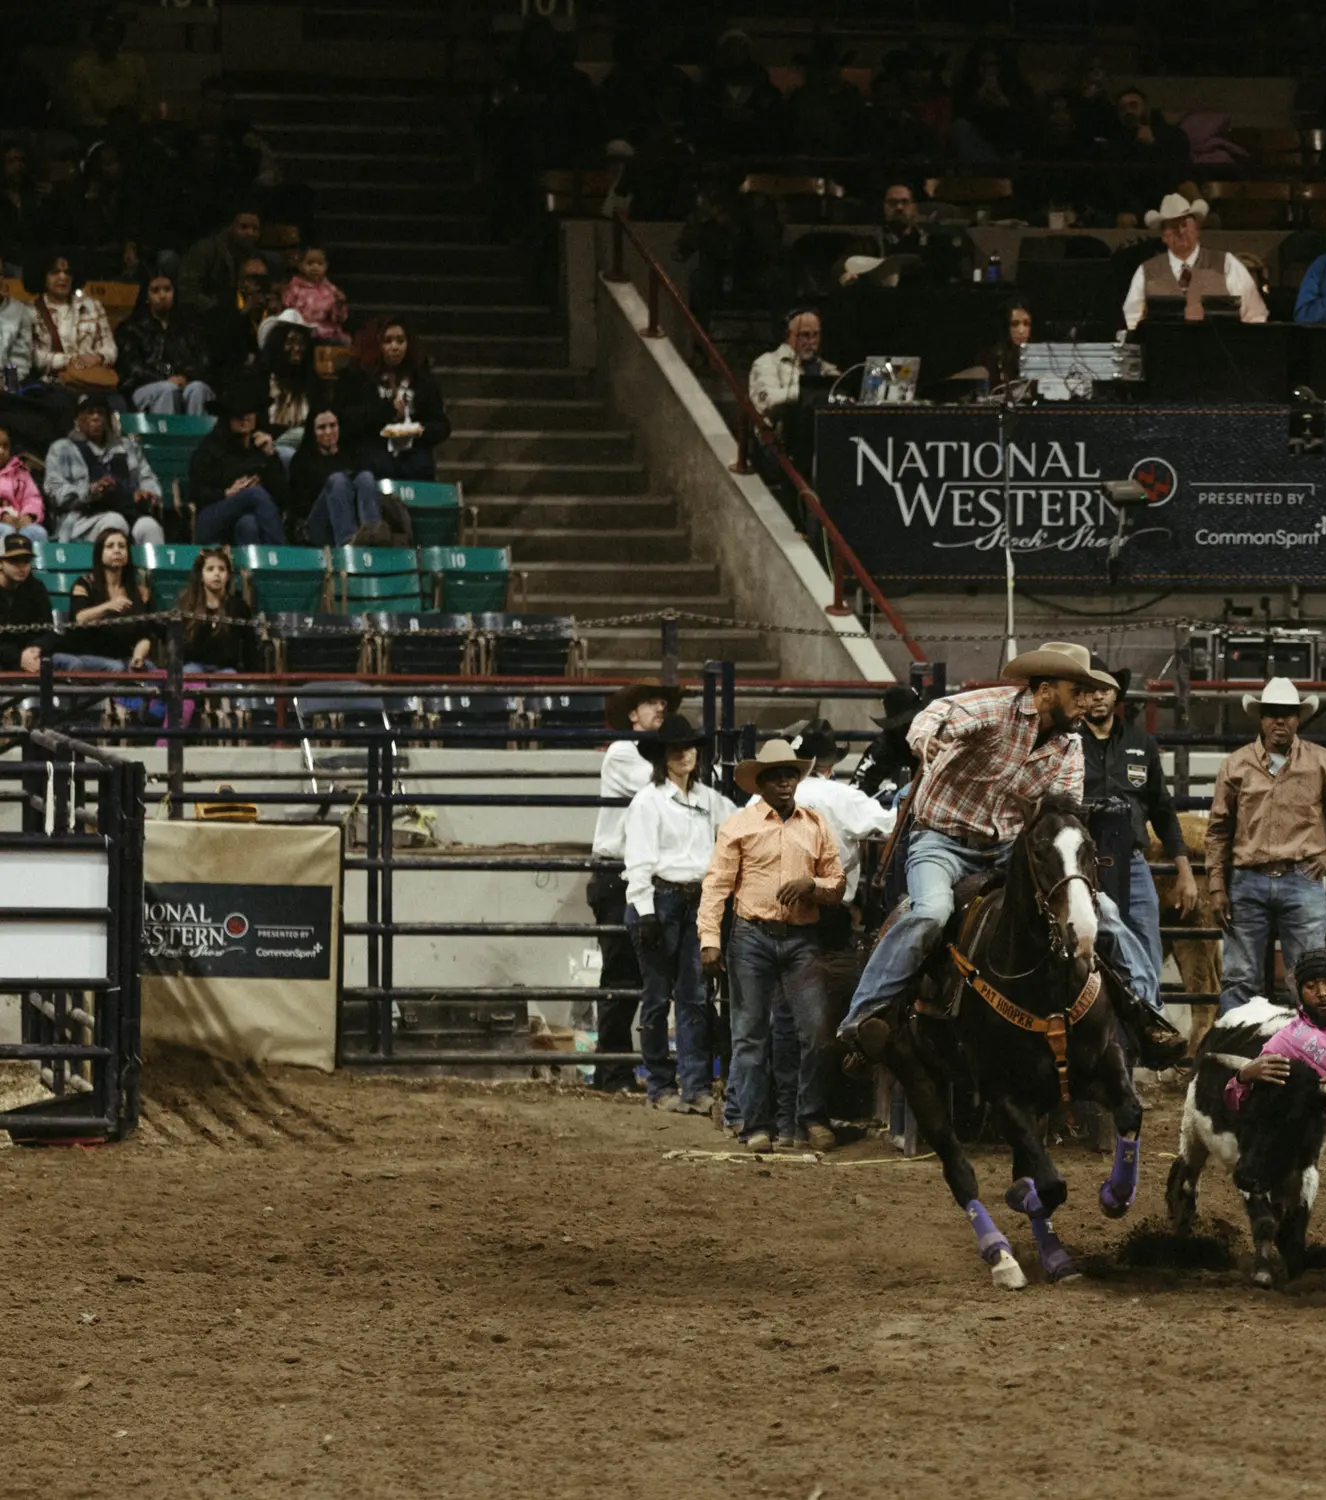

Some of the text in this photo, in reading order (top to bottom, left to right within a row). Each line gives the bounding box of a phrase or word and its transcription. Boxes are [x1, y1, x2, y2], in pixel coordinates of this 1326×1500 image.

[849, 437, 1100, 486] NATIONAL
[1198, 493, 1306, 505] PRESENTED BY
[1195, 529, 1321, 549] CommonSpirit
[451, 552, 467, 569] 10
[979, 983, 1035, 1029] PAT HOOPER
